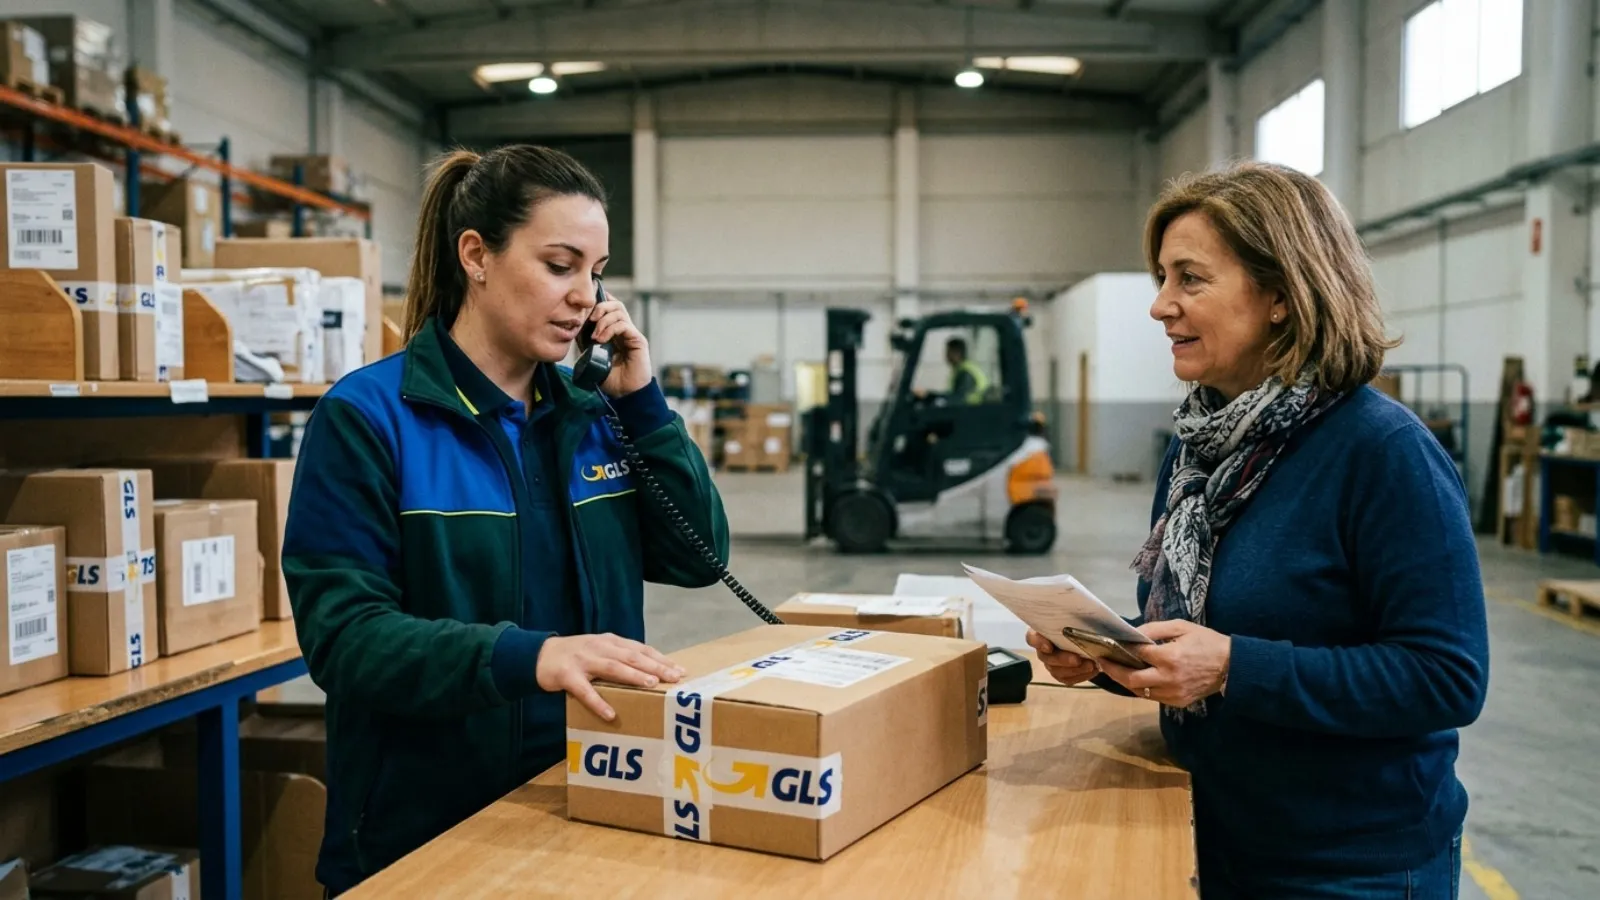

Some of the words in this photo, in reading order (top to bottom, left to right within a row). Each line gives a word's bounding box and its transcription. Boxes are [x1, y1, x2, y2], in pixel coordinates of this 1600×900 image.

[604, 459, 630, 479] GLS
[124, 479, 136, 519] GLS
[674, 690, 702, 754] GLS
[584, 743, 644, 781] GLS
[771, 767, 834, 806] GLS
[674, 799, 700, 840] LS
